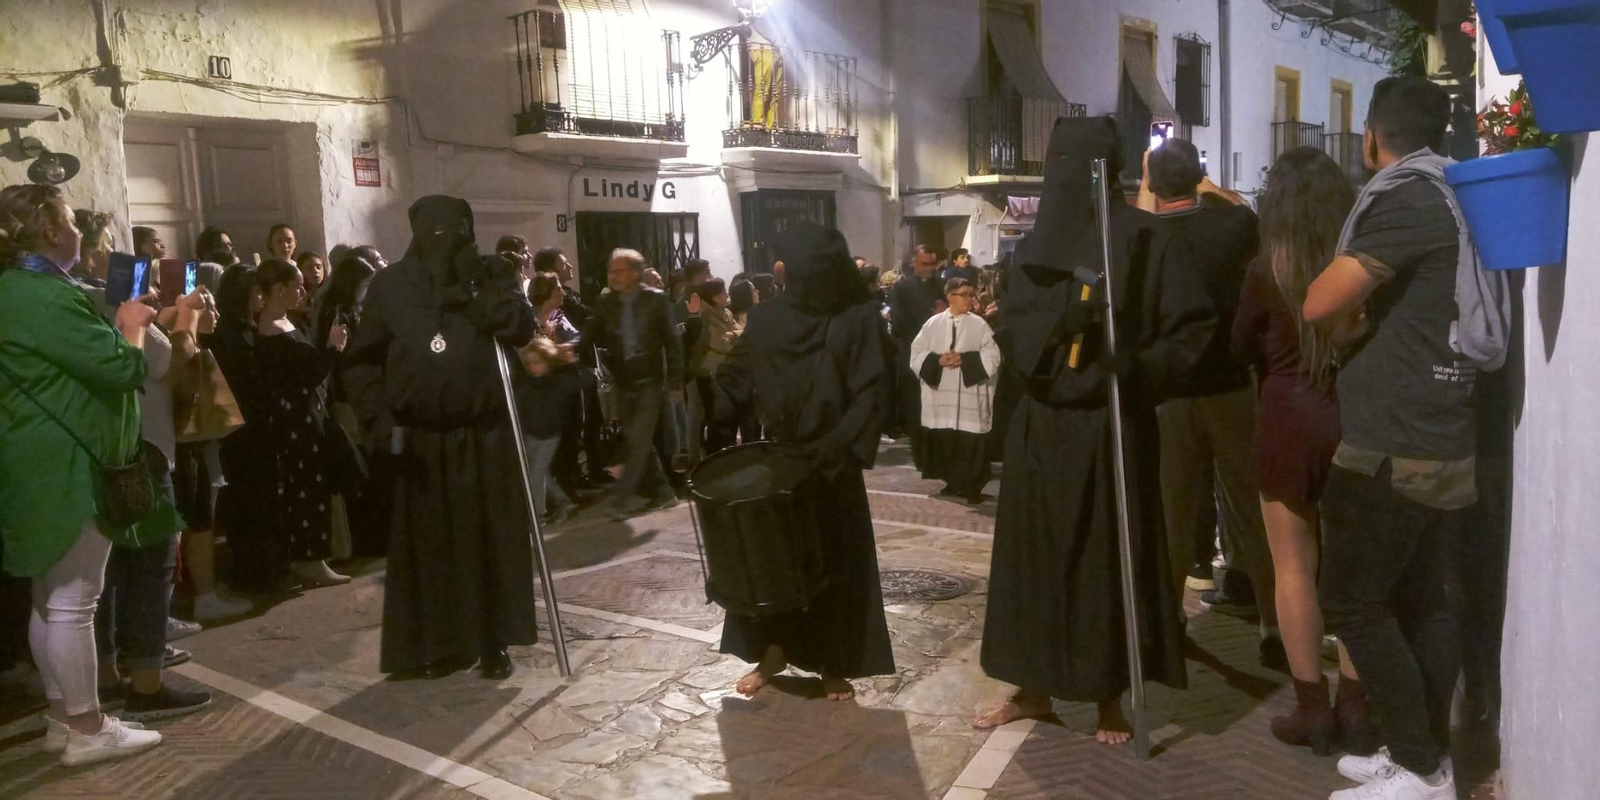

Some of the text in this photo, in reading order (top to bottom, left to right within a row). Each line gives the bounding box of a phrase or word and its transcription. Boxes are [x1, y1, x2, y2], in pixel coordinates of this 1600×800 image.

[211, 57, 230, 78] 10
[583, 178, 676, 202] Lindy G
[558, 215, 566, 231] 8
